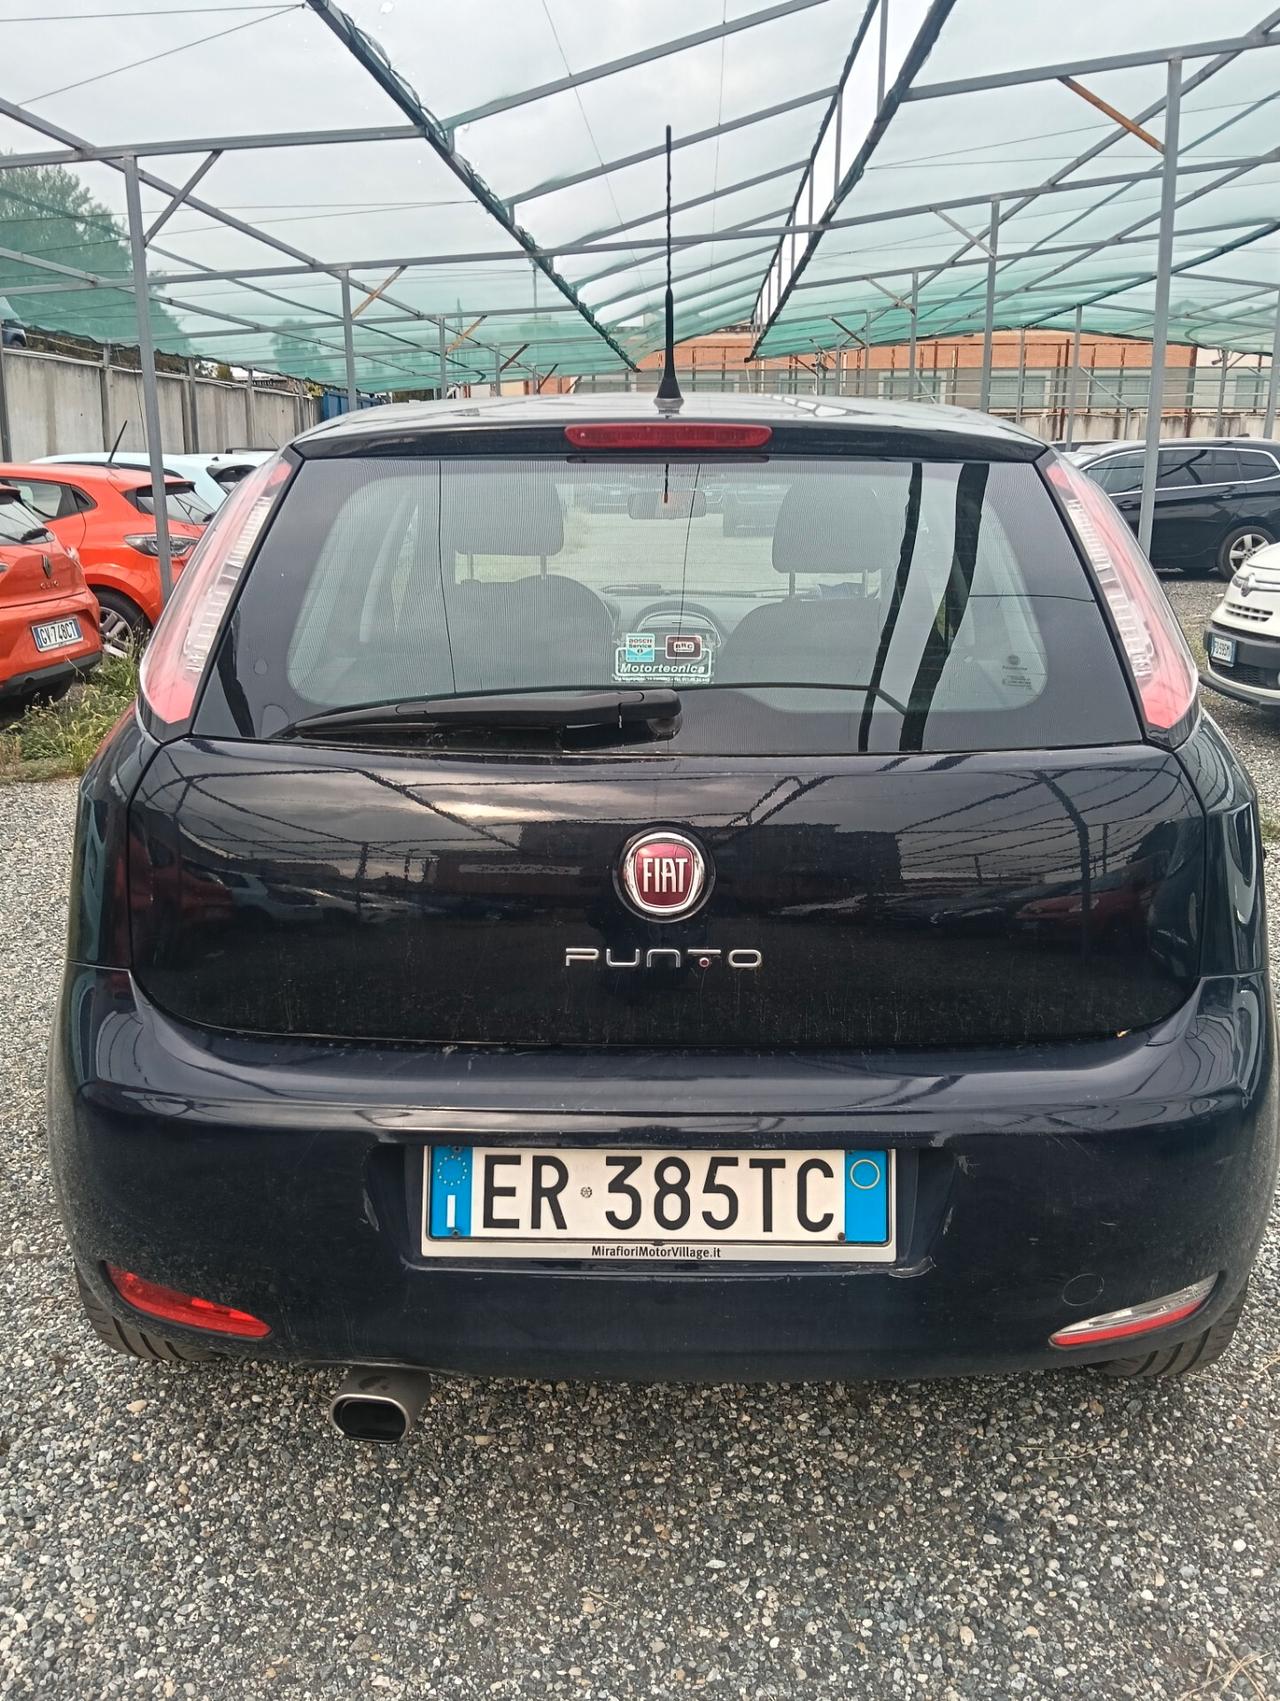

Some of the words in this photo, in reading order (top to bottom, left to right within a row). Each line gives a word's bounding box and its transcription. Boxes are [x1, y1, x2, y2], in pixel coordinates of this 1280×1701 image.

[51, 622, 76, 642] 748CT
[620, 663, 705, 673] Motortecnica
[642, 857, 688, 893] FIAT
[565, 947, 762, 968] PUNTO
[483, 1154, 569, 1230] ER
[604, 1156, 834, 1233] 385TC
[591, 1245, 721, 1259] MirafioriMotorVillage.it
